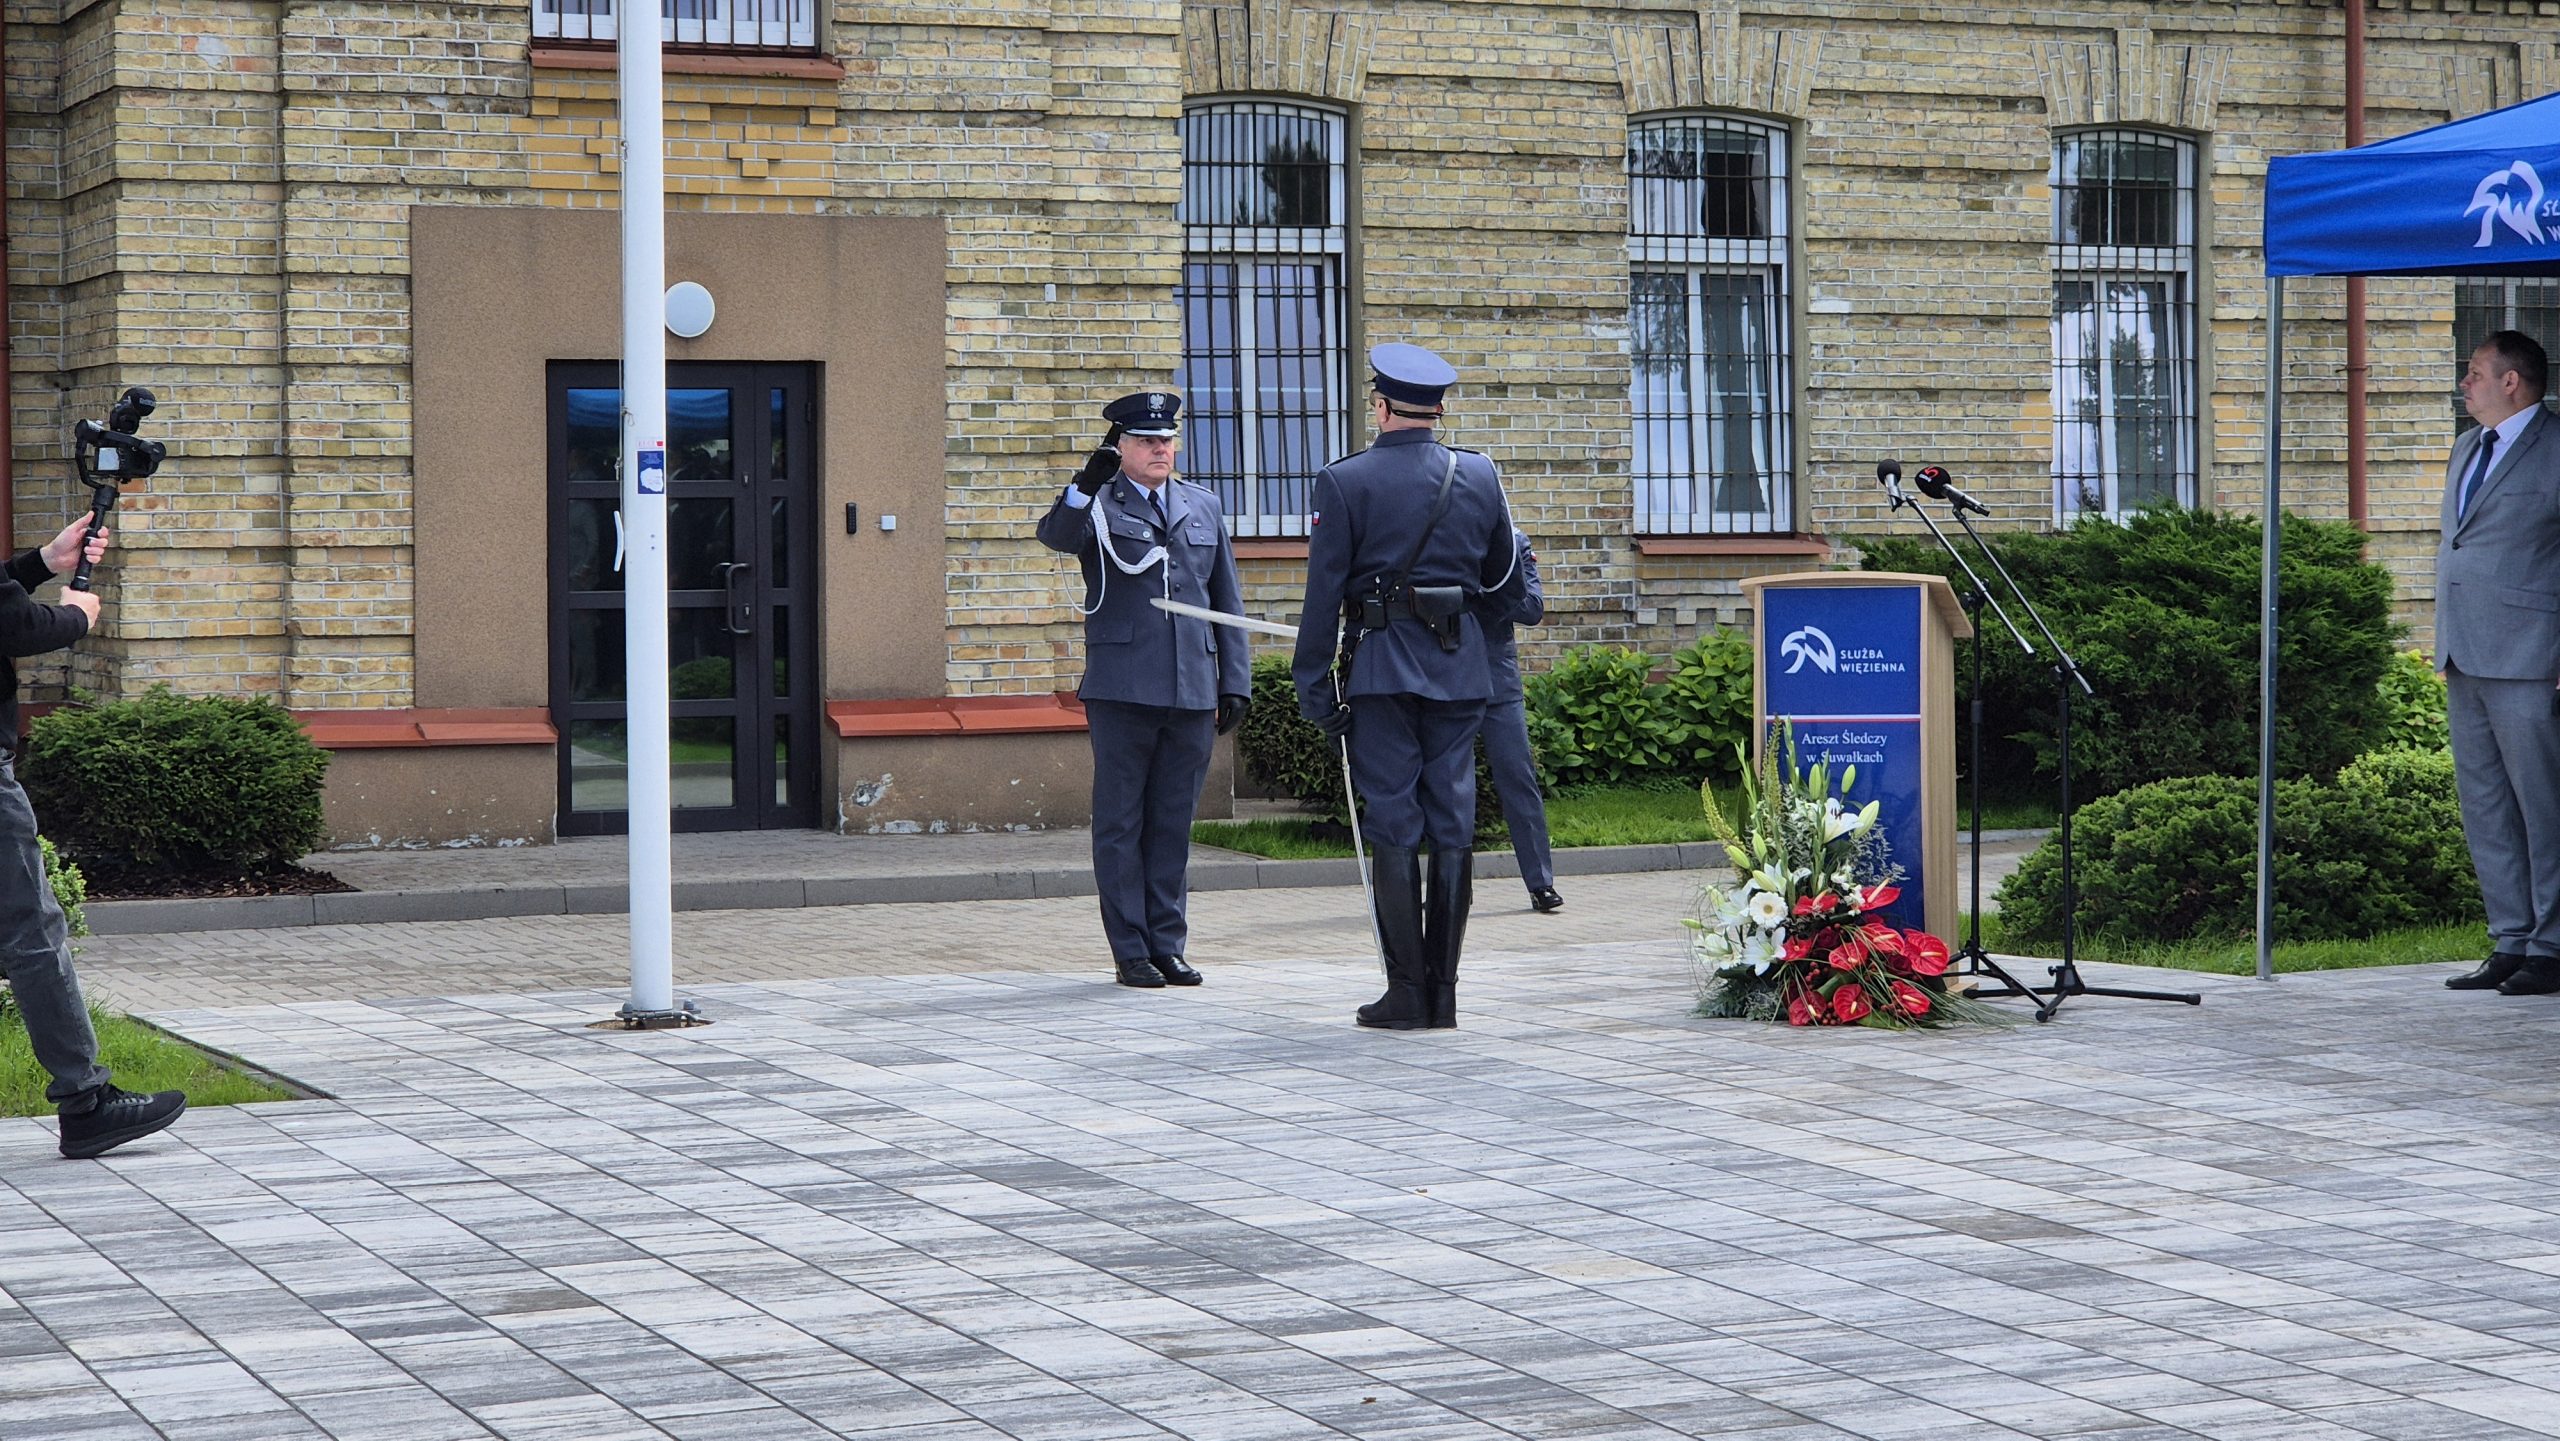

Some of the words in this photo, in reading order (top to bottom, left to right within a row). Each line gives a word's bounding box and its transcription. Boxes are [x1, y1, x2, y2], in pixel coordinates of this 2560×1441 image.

[1840, 662, 1906, 675] WIĘZIENNA
[1801, 733, 1839, 745] Areszt
[1842, 729, 1888, 747] Śledczy
[1806, 754, 1817, 763] w
